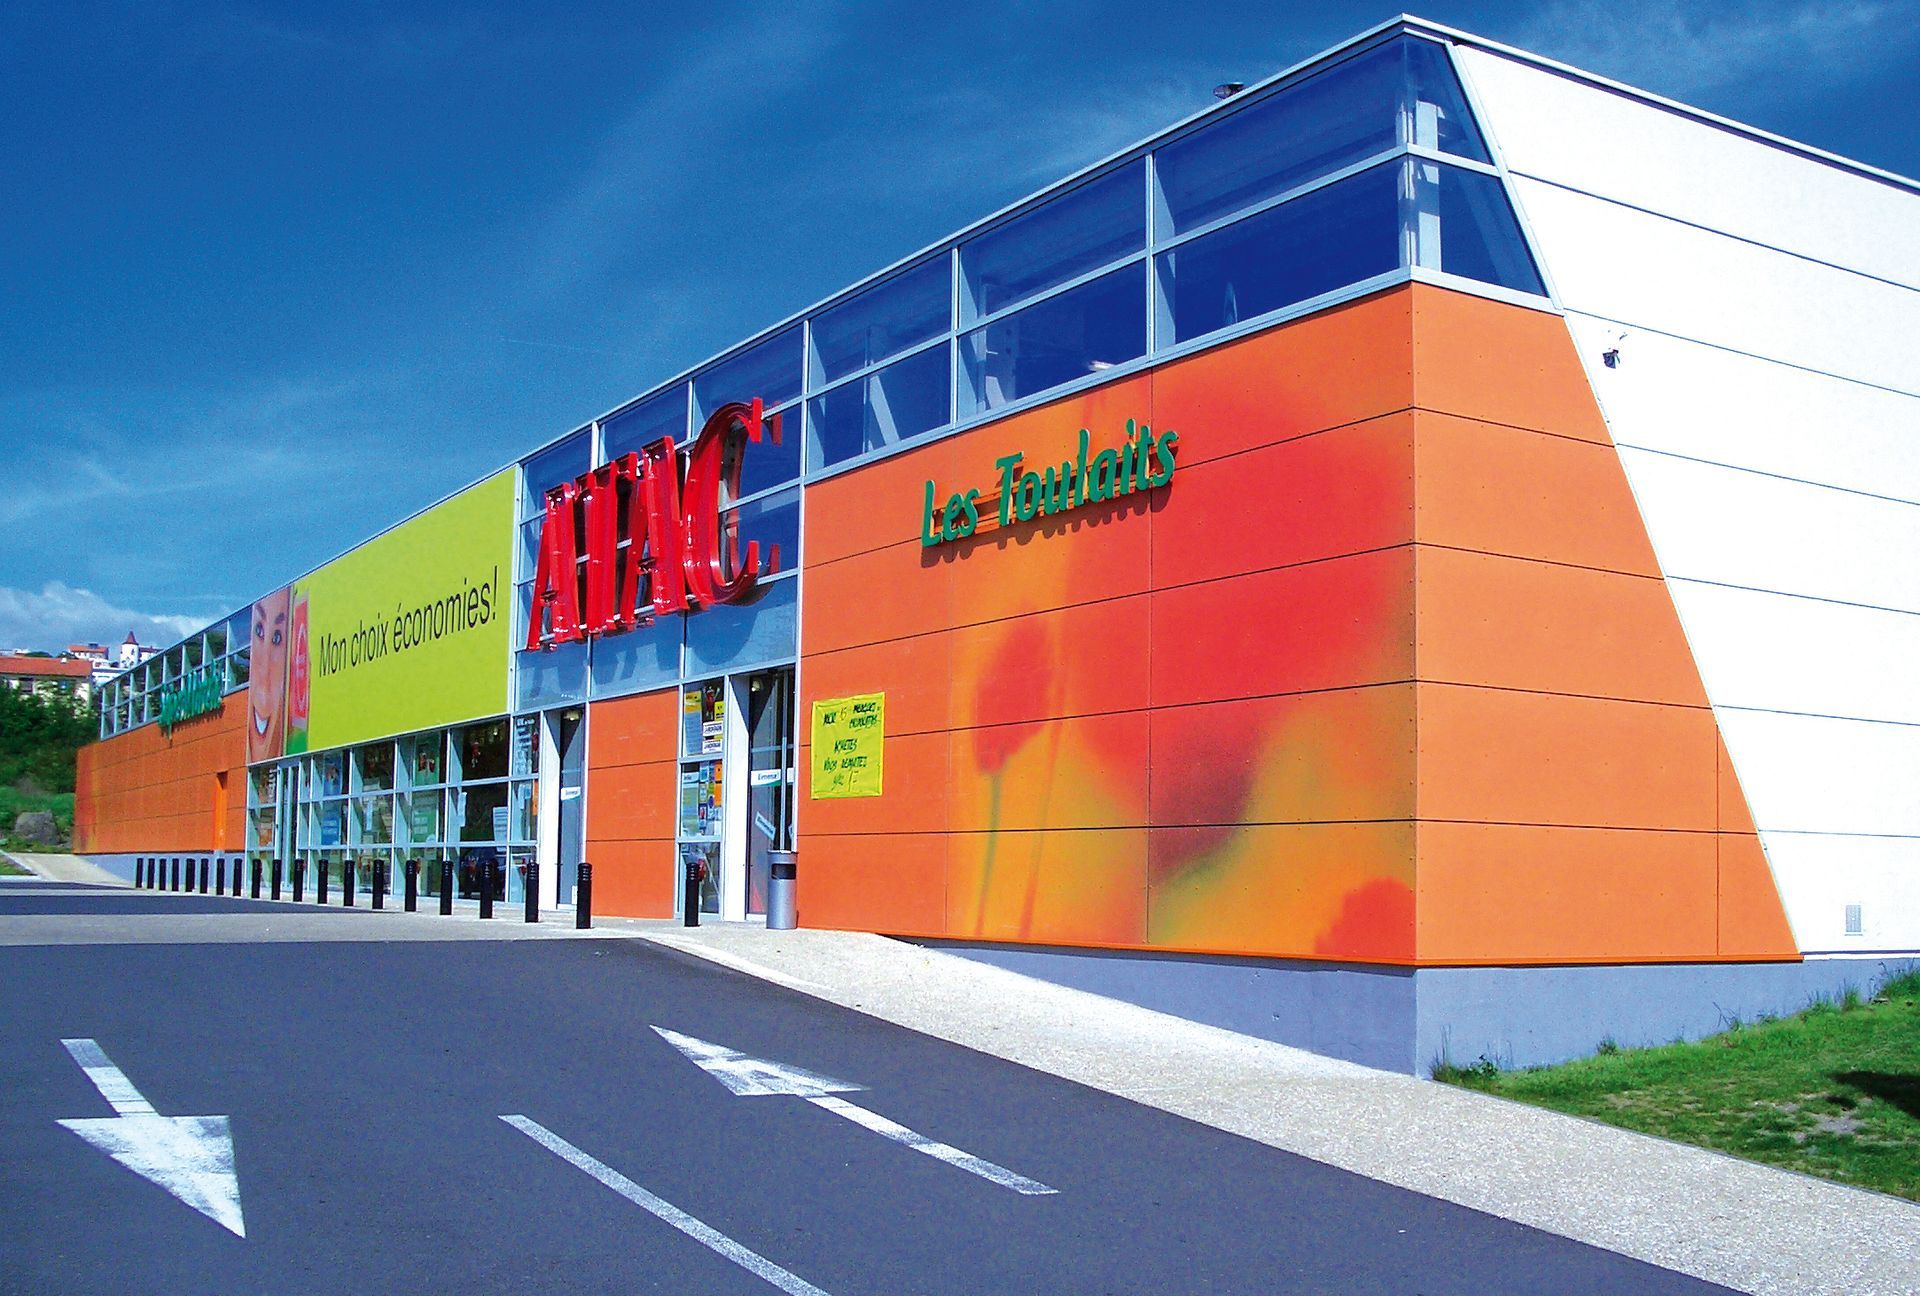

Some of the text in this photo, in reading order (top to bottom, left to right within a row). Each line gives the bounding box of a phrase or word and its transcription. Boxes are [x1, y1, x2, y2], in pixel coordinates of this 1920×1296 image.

[921, 418, 1179, 547] Les Toulaits
[319, 565, 498, 678] Mon choix économies!
